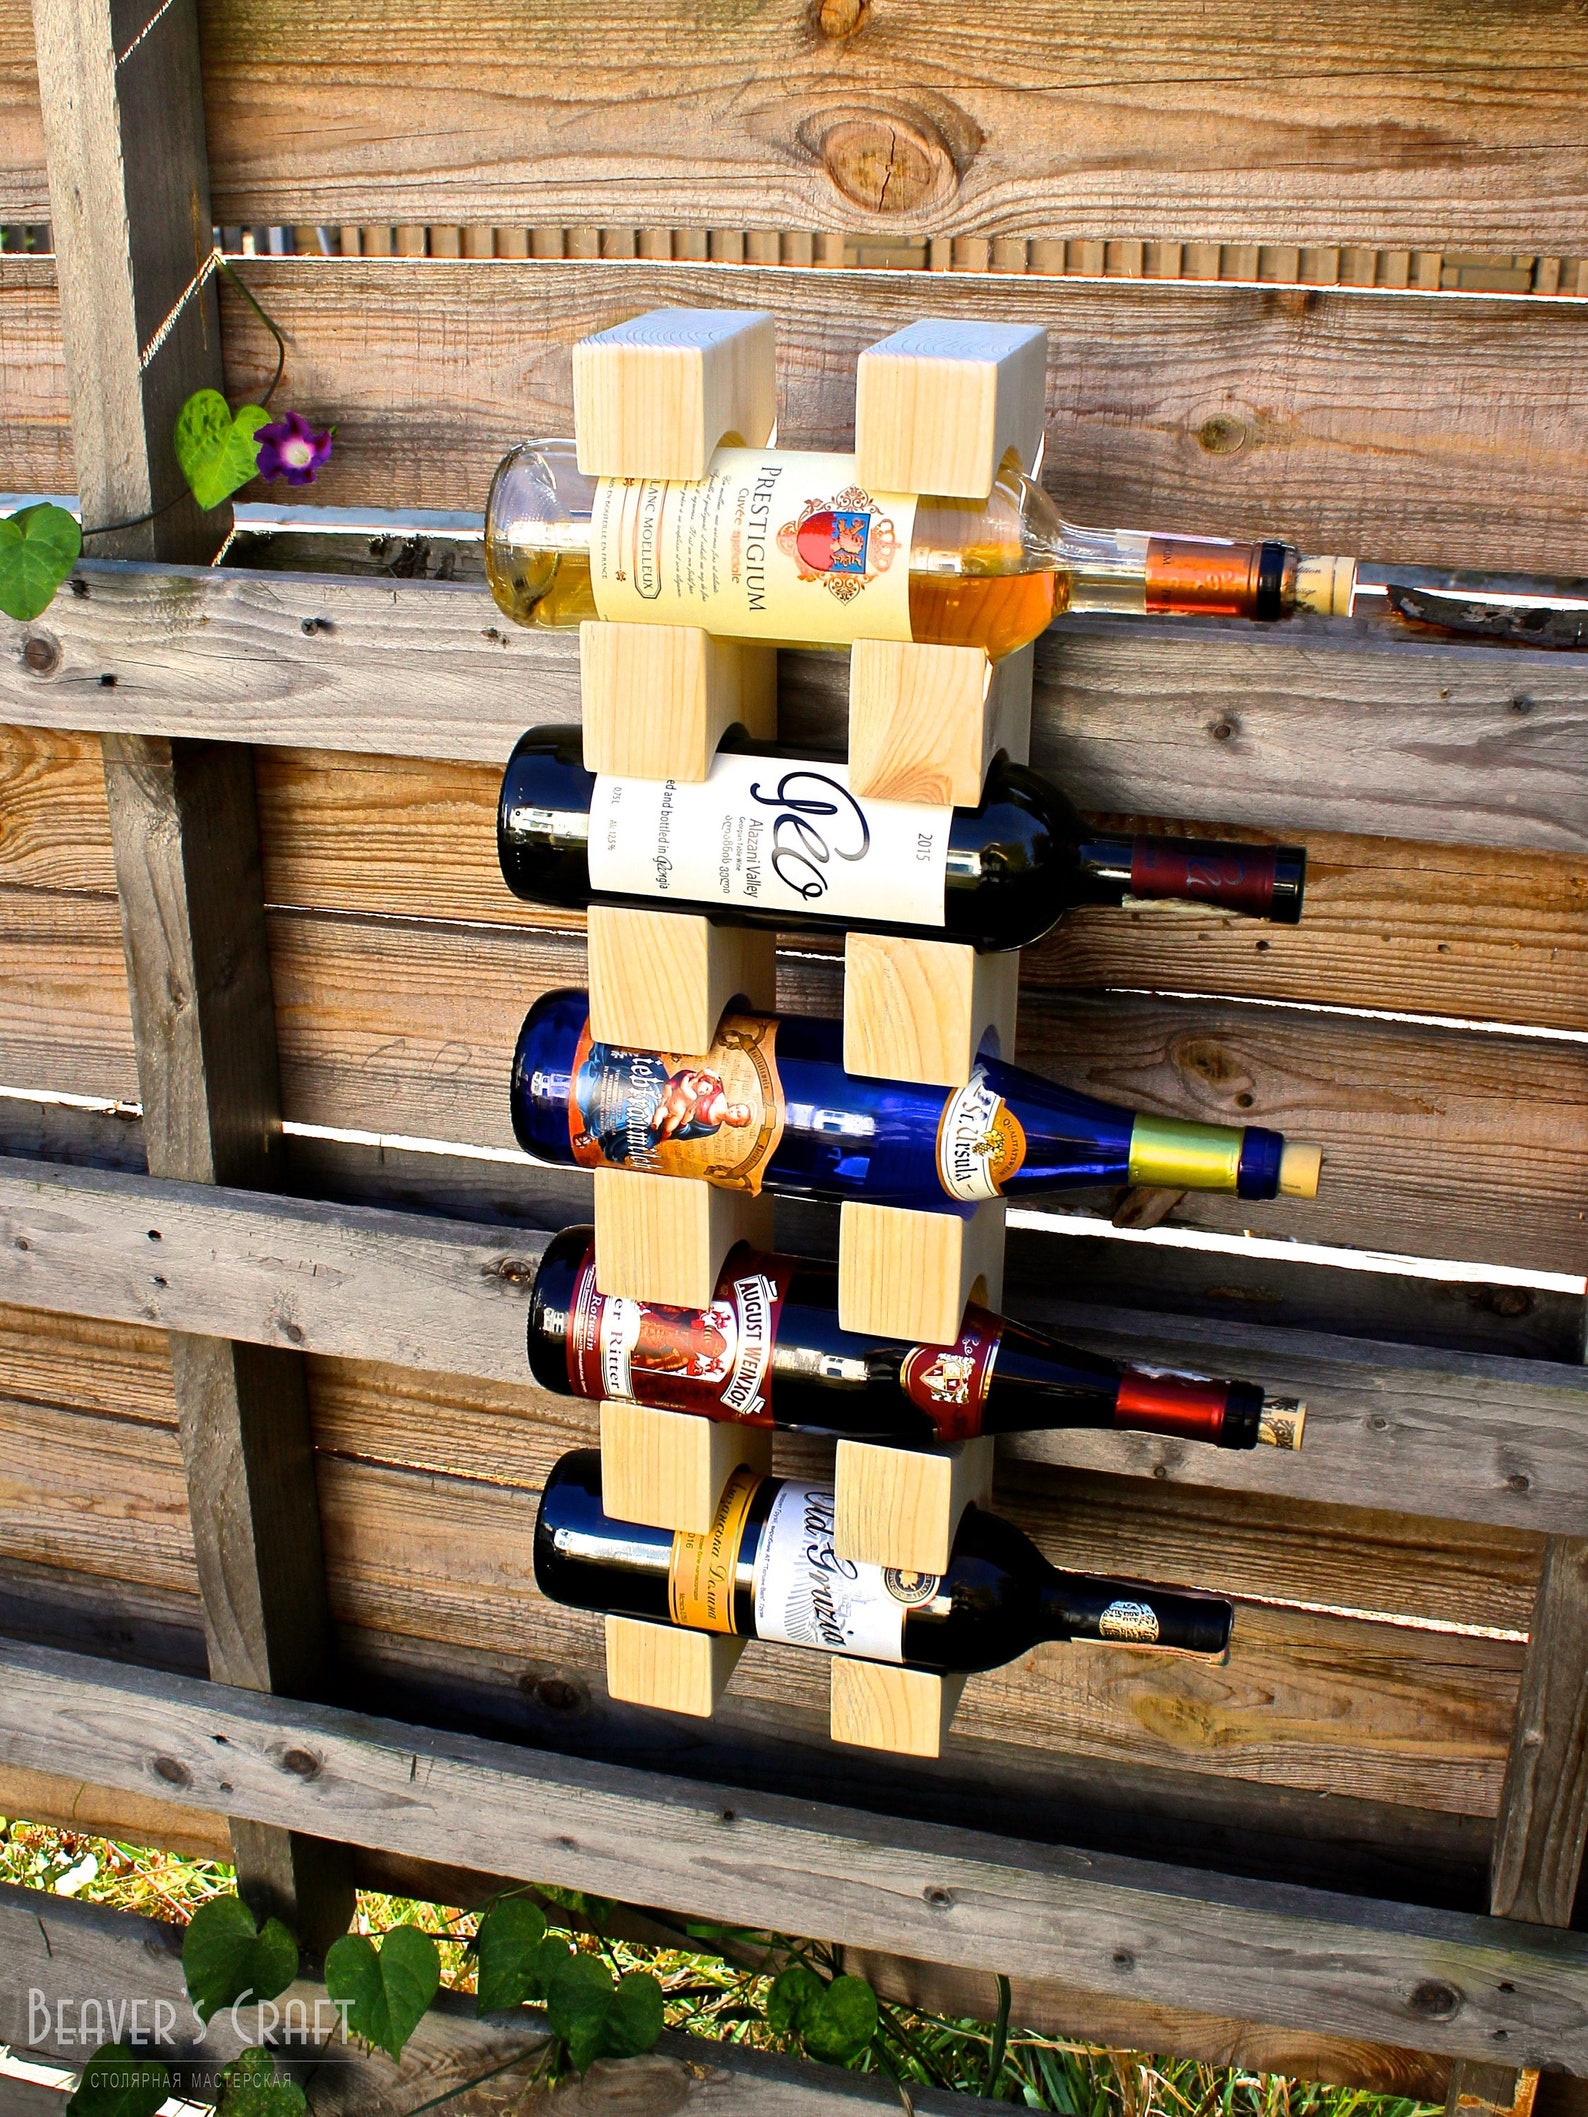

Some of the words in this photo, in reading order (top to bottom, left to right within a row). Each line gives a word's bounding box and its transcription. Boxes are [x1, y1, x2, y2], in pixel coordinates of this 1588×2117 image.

[645, 479, 660, 512] LANC
[734, 487, 750, 525] Cuvée
[641, 517, 654, 590] MOELLEUX
[746, 466, 783, 612] PRESTIGIUM
[662, 792, 674, 809] and
[658, 810, 673, 844] bottled
[746, 818, 764, 863] Alazani
[658, 845, 669, 854] in
[917, 833, 933, 862] 2015
[743, 866, 762, 898] Valley
[625, 1054, 665, 1170] iebfraumilch
[587, 1294, 602, 1351] Rotwein
[613, 1298, 623, 1321] er
[740, 1282, 762, 1341] AUGUST
[608, 1331, 623, 1390] Ritter
[686, 1532, 696, 1549] 016
[707, 1562, 727, 1620] Долина
